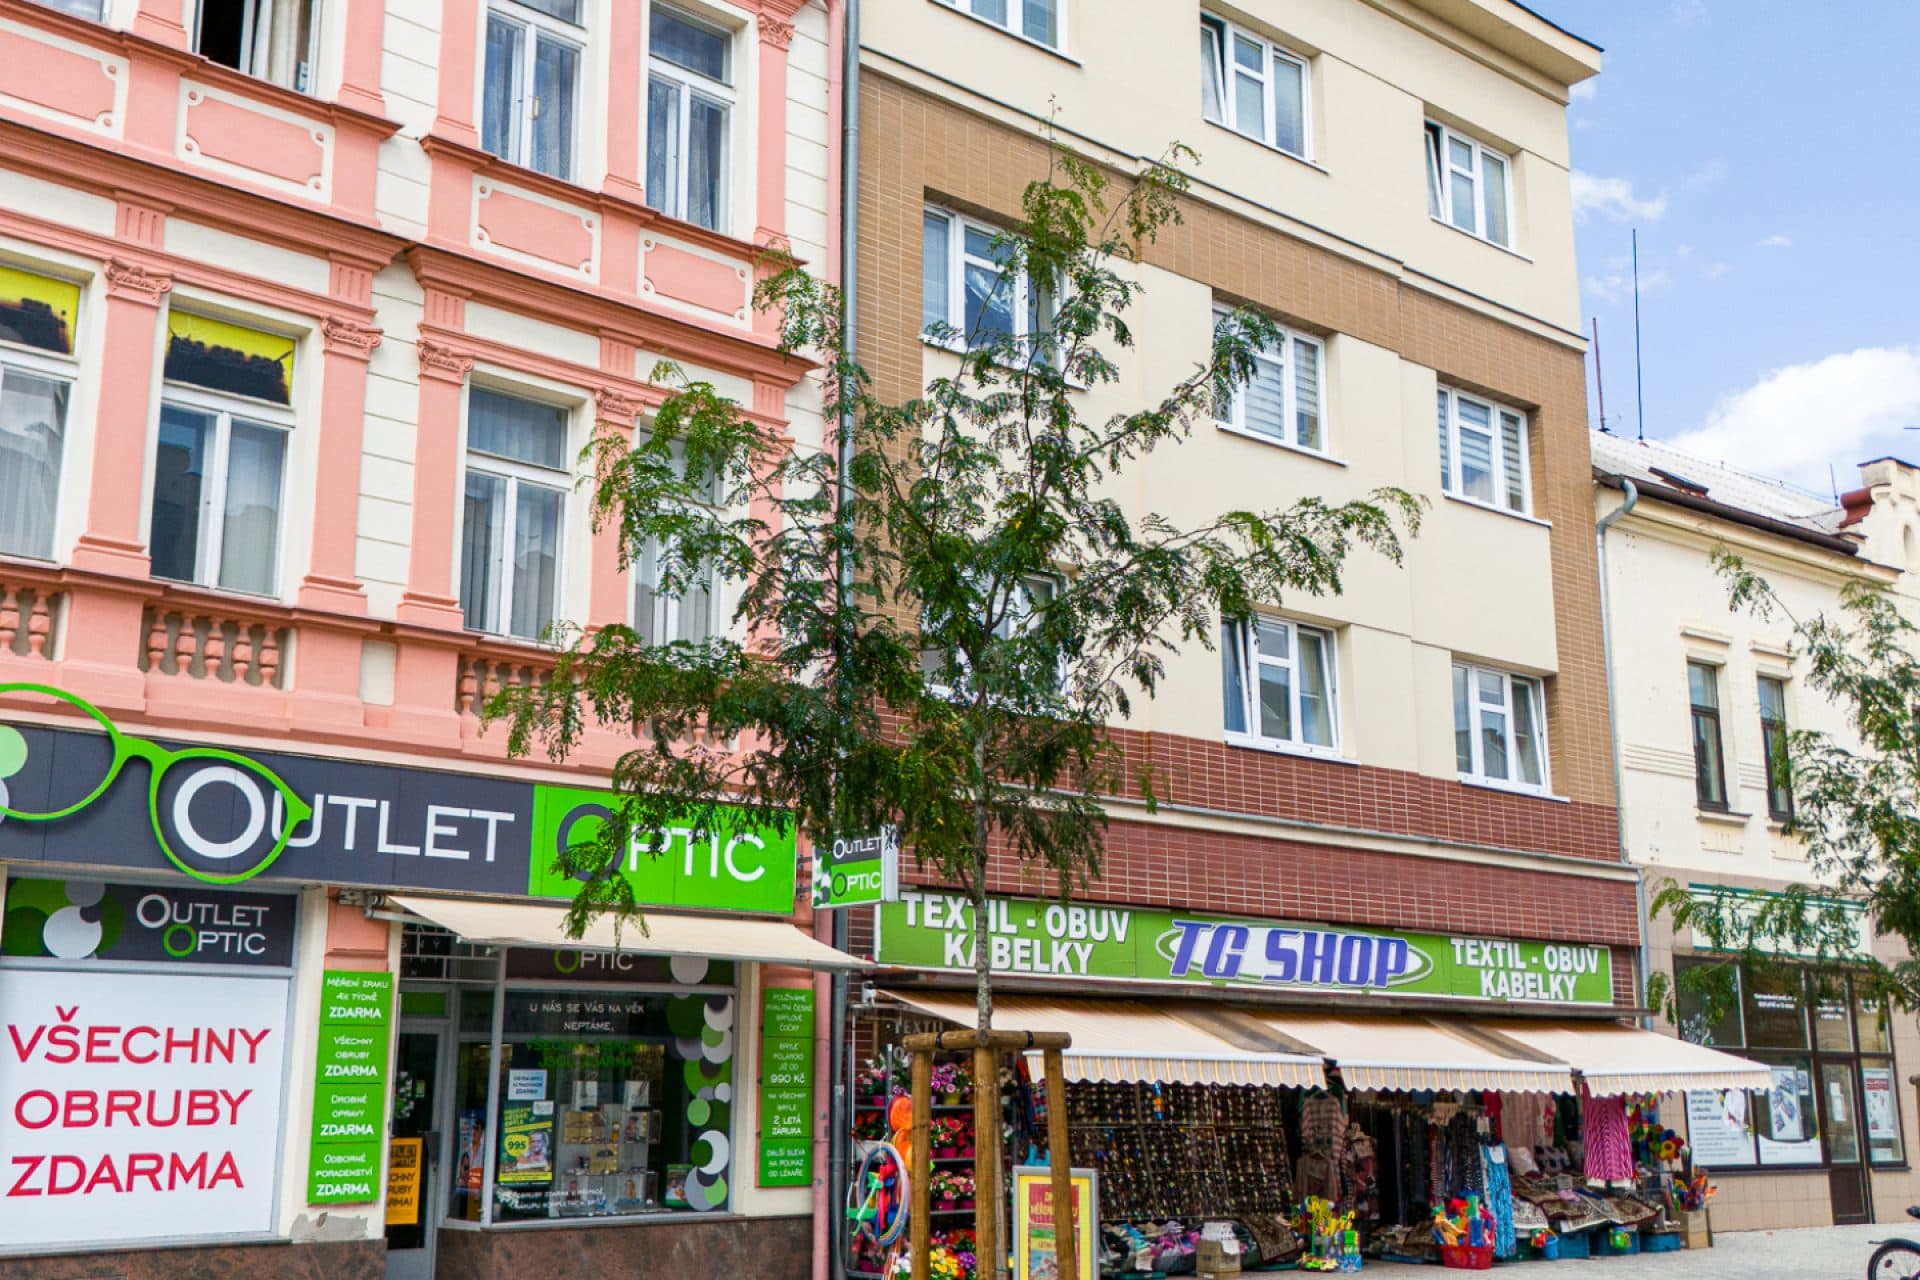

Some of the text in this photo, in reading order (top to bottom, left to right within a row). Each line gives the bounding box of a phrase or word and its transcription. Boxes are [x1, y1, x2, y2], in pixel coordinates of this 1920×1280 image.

[173, 766, 514, 862] OUTLET
[557, 803, 764, 882] OPTIC
[833, 836, 882, 859] OUTLET
[831, 871, 881, 897] OPTIC
[136, 894, 270, 928] OUTLET
[1045, 905, 1129, 943] OBUV
[163, 923, 266, 957] OPTIC
[553, 950, 632, 974] OPTIC
[1263, 928, 1409, 988] SHOP
[1450, 938, 1526, 969] TEXTIL
[1543, 945, 1599, 974] OBUV
[1480, 969, 1576, 1000] KABELKY
[329, 1006, 381, 1018] ZDARMA
[529, 1003, 538, 1013] U
[542, 1000, 562, 1013] NÁS
[566, 1003, 580, 1013] SE
[609, 1005, 621, 1013] NA
[8, 1005, 271, 1064] VŠECHNY
[325, 1065, 378, 1077] ZDARMA
[770, 1074, 791, 1083] 990
[14, 1089, 253, 1129] OBRUBY
[320, 1123, 374, 1136] ZDARMA
[507, 1141, 527, 1150] 995
[6, 1151, 244, 1197] ZDARMA
[316, 1183, 370, 1196] ZDARMA
